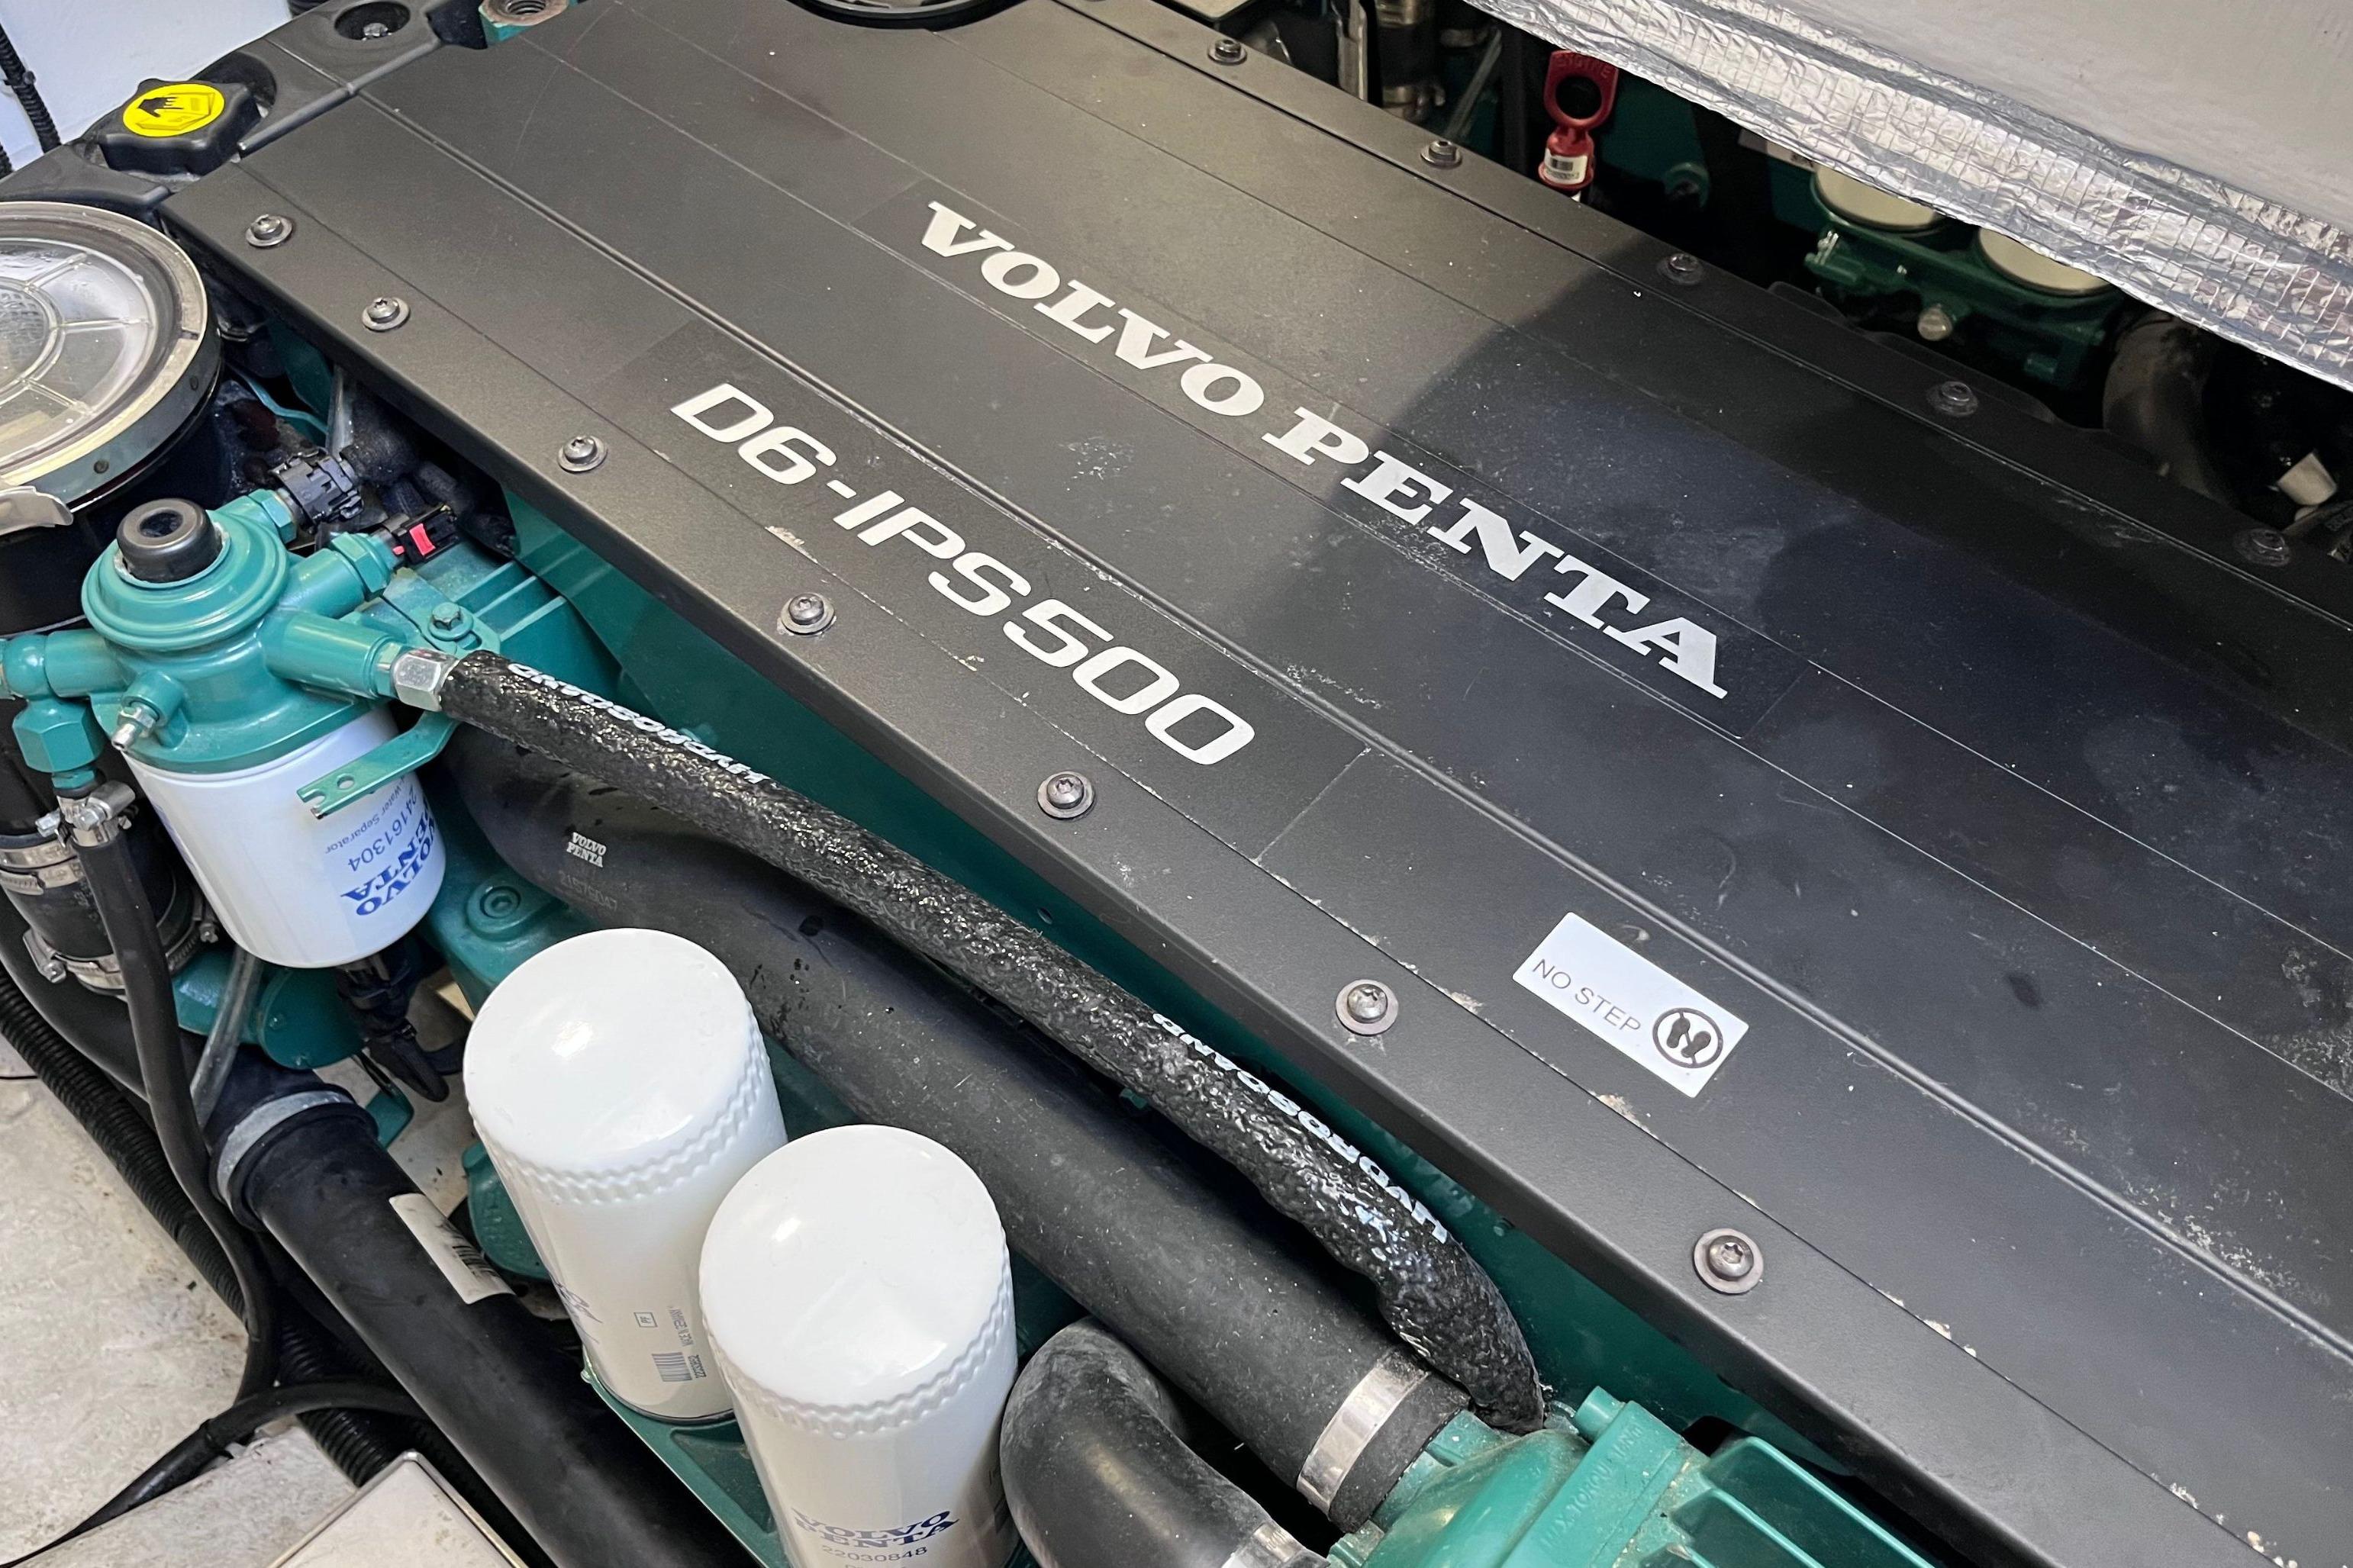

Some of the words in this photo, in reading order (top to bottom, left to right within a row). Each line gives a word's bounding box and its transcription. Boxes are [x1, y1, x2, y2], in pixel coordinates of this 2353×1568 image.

[918, 201, 1265, 417] VOLVO
[1261, 406, 1728, 700] PENTA
[669, 382, 1255, 765] D6-IPS500
[325, 813, 381, 855] Separator
[347, 786, 417, 872] 24161304
[566, 841, 604, 868] PENTA
[572, 831, 608, 856] VOLVO
[356, 815, 435, 916] VOLVO
[1532, 958, 1571, 990] NO
[1574, 987, 1642, 1032] STEP
[1152, 1013, 1449, 1244] HYDROSCAND
[790, 1507, 951, 1539] VOLVO
[794, 1516, 960, 1548] PENTA
[821, 1544, 928, 1563] 22030848
